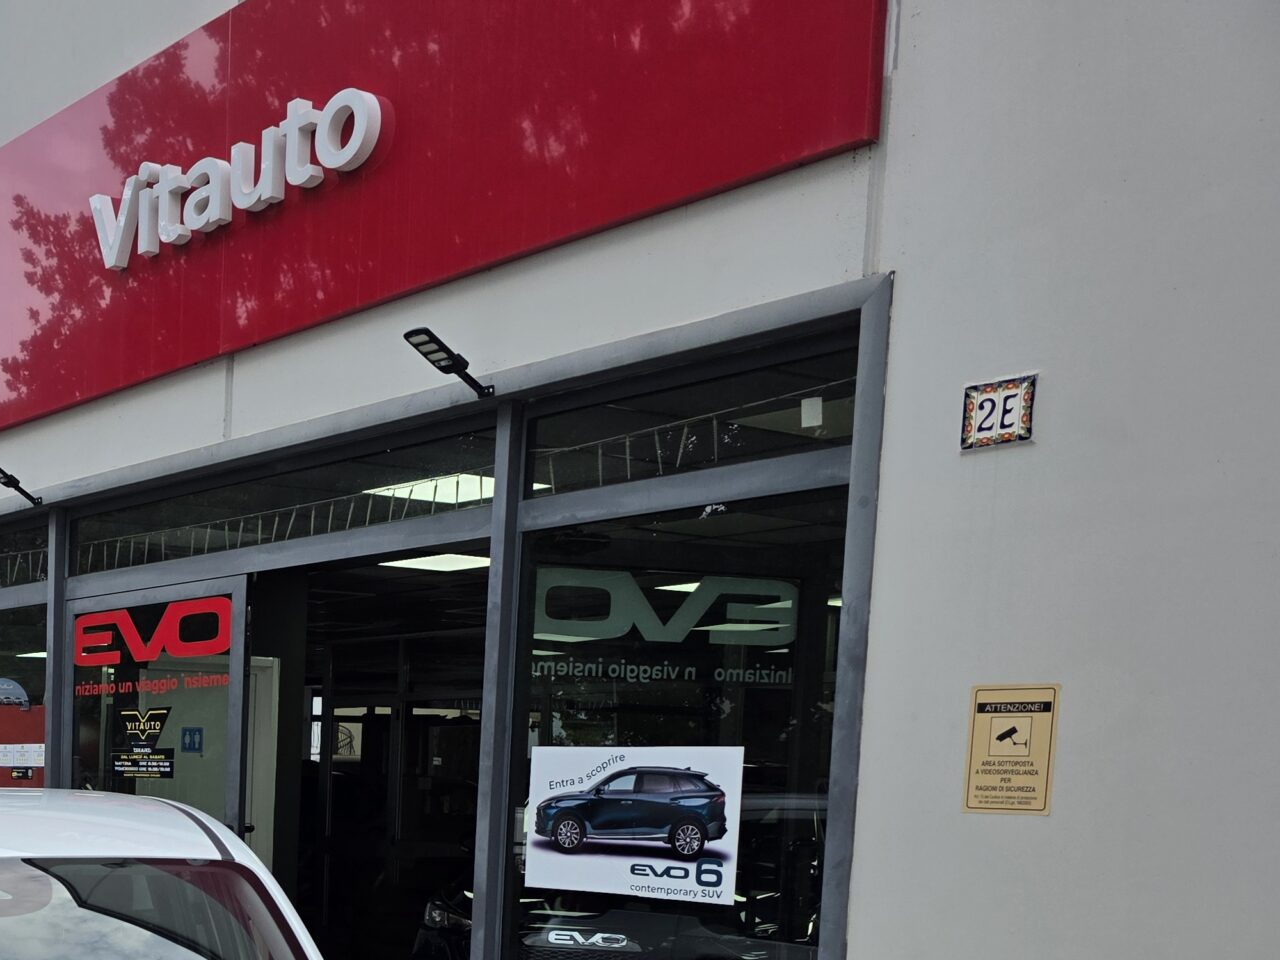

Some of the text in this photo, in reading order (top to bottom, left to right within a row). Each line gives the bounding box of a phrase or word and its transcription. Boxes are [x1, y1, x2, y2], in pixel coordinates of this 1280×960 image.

[89, 87, 383, 271] Vitauto
[976, 391, 1019, 433] 2E
[74, 596, 232, 666] EVO
[118, 681, 133, 693] un
[136, 674, 178, 693] viaggio
[984, 703, 1044, 712] ATTENZIONE!
[126, 721, 161, 730] VITAUTO
[548, 752, 627, 790] Entra a scoprire
[980, 768, 1039, 776] VIDEOSORVEGLIANZA
[630, 858, 723, 888] EVO 6
[630, 882, 723, 899] contemporary SUV
[547, 930, 628, 948] EVO
